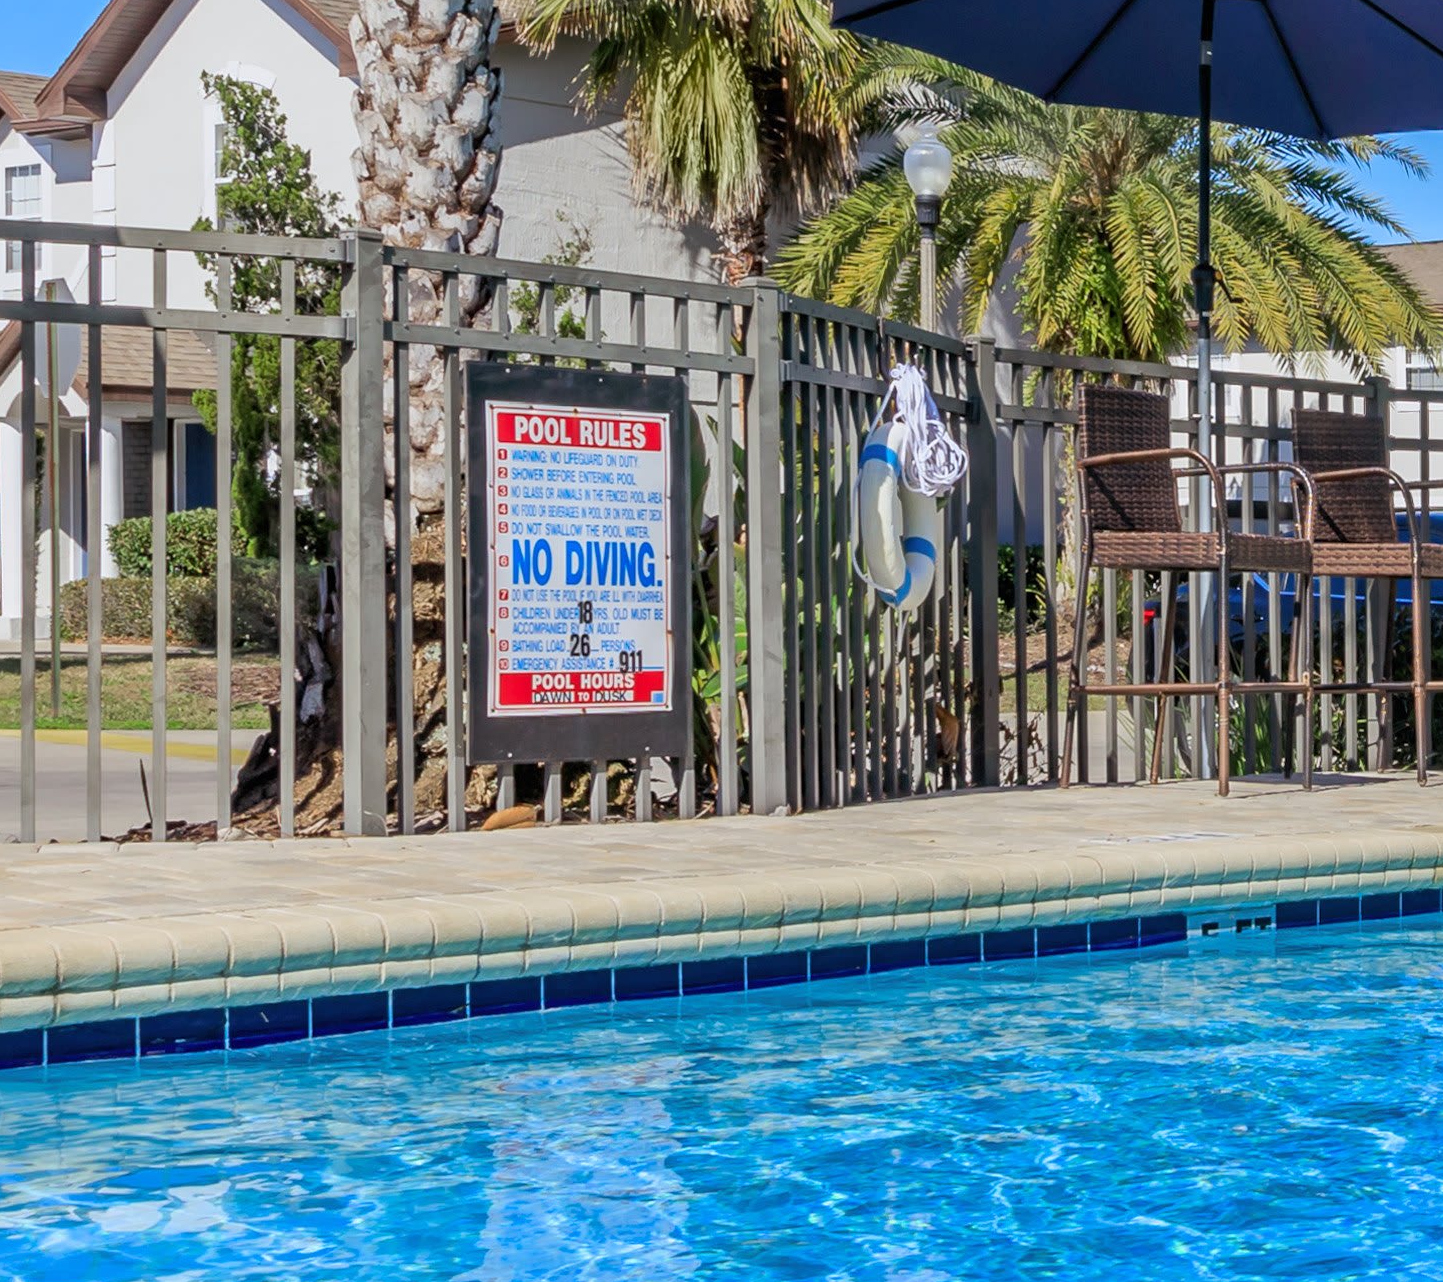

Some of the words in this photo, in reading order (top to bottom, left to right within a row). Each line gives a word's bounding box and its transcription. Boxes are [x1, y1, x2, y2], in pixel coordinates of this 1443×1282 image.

[514, 415, 572, 444] POOL
[579, 418, 646, 449] RULES
[550, 451, 561, 464] NO
[564, 452, 603, 466] LIFEGUARD
[606, 454, 617, 467] ON
[499, 467, 507, 478] 2
[512, 467, 544, 480] SHOWER
[547, 468, 576, 483] BEFORE
[579, 470, 614, 485] ENTERING
[499, 485, 507, 496] 3
[511, 485, 521, 497] NO
[523, 486, 543, 498] GLASS
[546, 487, 554, 499] OR
[557, 488, 582, 500] ANIMALS
[585, 489, 590, 500] IN
[592, 489, 603, 501] THE
[630, 491, 646, 503] POOL
[499, 504, 507, 514] 4
[511, 504, 519, 517] NO
[588, 506, 603, 519] POOL
[499, 522, 508, 533] 5
[512, 521, 523, 535] DO
[526, 522, 542, 535] NOT
[545, 523, 583, 536] SWALLOW
[585, 523, 600, 537] THE
[603, 524, 622, 538] POOL
[500, 557, 508, 566] 6
[512, 538, 553, 586] NO
[565, 540, 663, 588] DIVING.
[500, 590, 508, 600] 7
[512, 589, 521, 601] DO
[523, 589, 534, 601] NOT
[537, 589, 548, 601] USE
[550, 589, 561, 602] THE
[563, 589, 578, 602] POOL
[500, 608, 508, 618] 8
[513, 606, 550, 619] CHILDREN
[554, 607, 579, 620] UNDER
[577, 600, 593, 624] 18
[613, 607, 628, 620] OLD
[631, 608, 651, 620] MUST
[654, 608, 663, 620] BE
[513, 622, 567, 635] ACCOMPANIED
[584, 622, 594, 635] AN
[500, 640, 508, 651] 9
[512, 639, 543, 652] BATHING
[546, 639, 566, 653] LOAD
[570, 634, 590, 657] 26
[499, 659, 508, 669] 10
[512, 657, 558, 670] EMERGENCY
[561, 657, 606, 670] ASSISTANCE
[619, 650, 643, 674] 911
[532, 673, 575, 690] POOL
[580, 673, 635, 690] HOURS
[534, 691, 572, 704] DAWN
[577, 692, 590, 702] TO
[595, 691, 626, 703] DUSK
